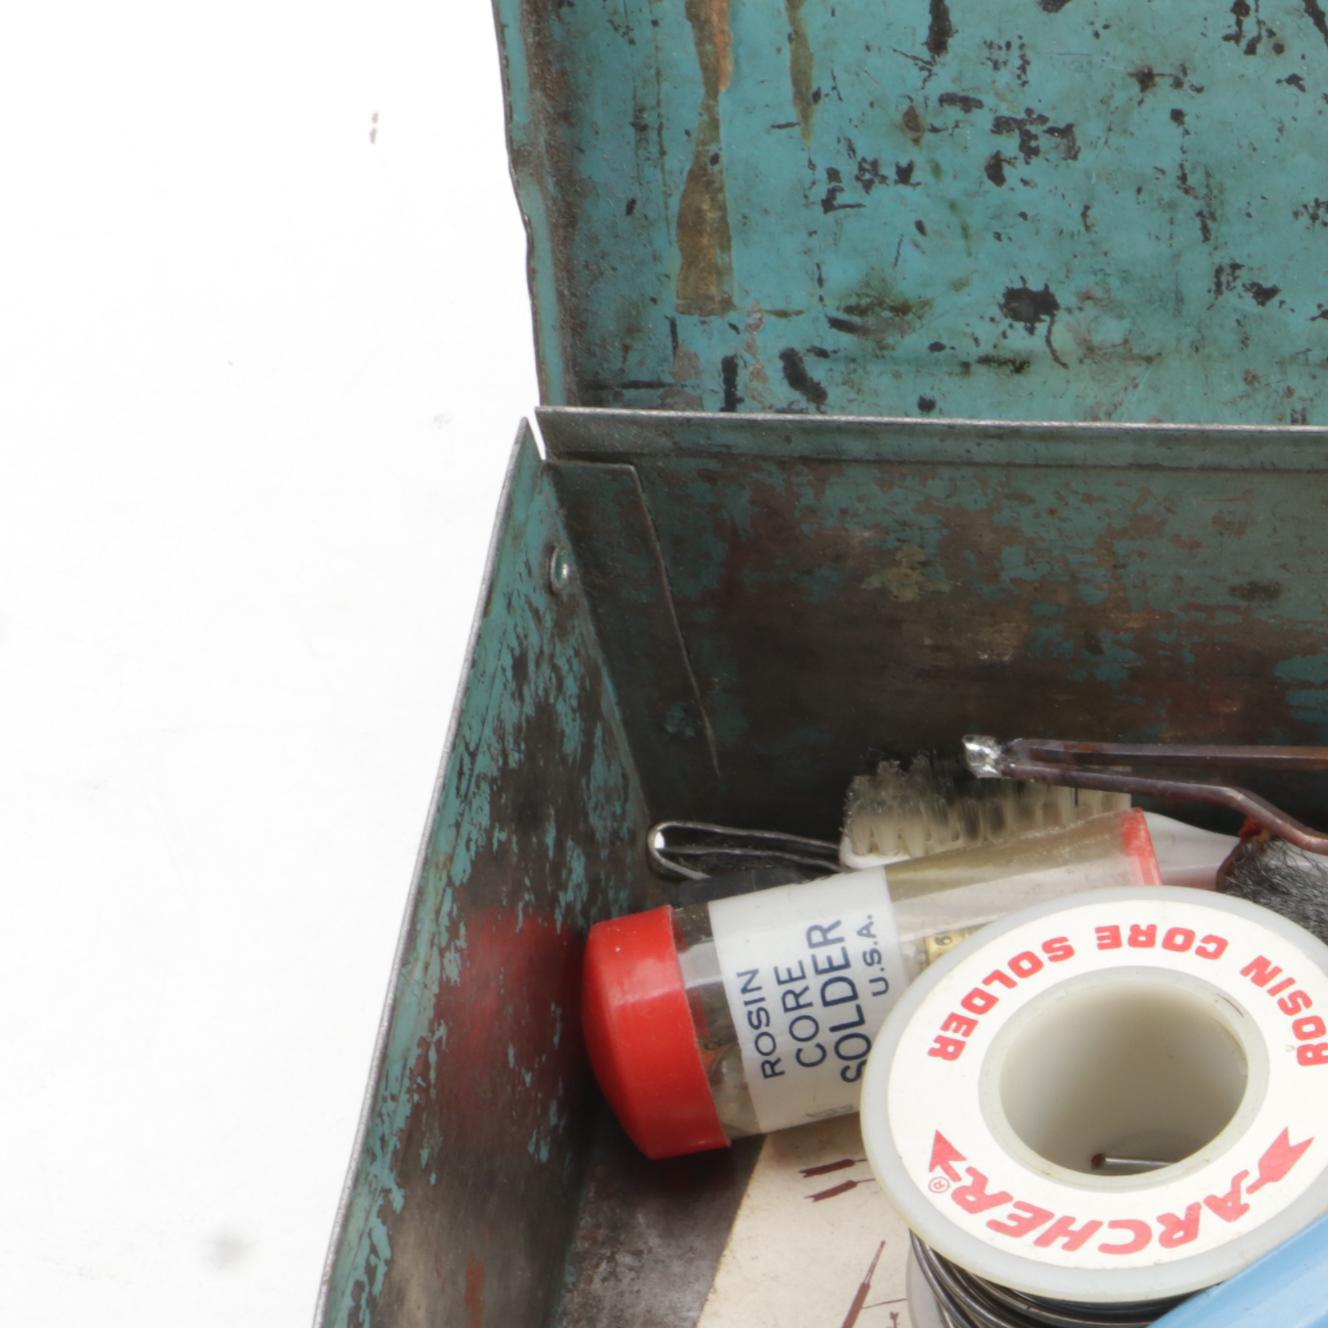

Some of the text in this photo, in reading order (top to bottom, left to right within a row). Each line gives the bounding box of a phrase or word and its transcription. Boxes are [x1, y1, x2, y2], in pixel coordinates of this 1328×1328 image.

[856, 914, 889, 997] U.S.A.
[1093, 923, 1230, 961] CORE
[736, 968, 785, 1080] ROSIN
[773, 959, 827, 1068] CORE
[805, 919, 872, 1083] SOLDER
[927, 936, 1076, 1062] SOLDER
[950, 1164, 1265, 1256] ARCHER
